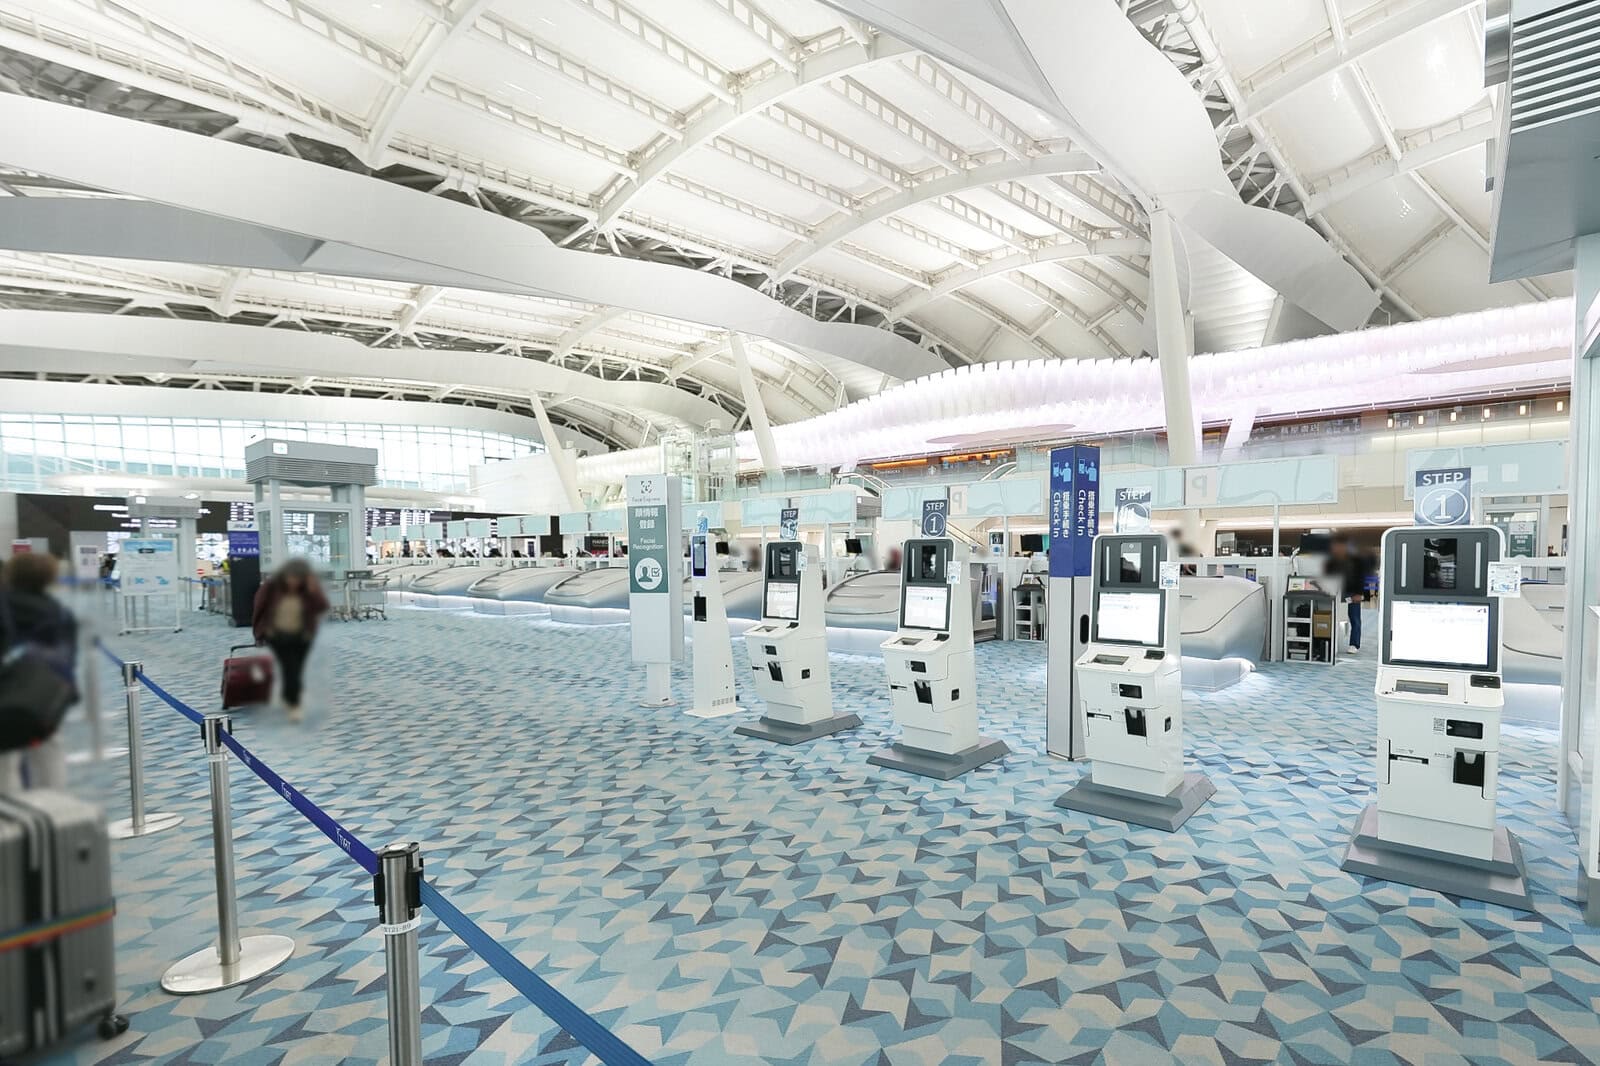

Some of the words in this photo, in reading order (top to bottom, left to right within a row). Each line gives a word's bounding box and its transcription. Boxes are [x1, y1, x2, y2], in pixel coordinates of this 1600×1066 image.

[1422, 472, 1464, 486] STEP
[1119, 489, 1146, 501] STEP
[925, 502, 945, 511] STEP
[1053, 492, 1061, 526] Check
[1077, 489, 1086, 523] Check
[1434, 494, 1451, 520] 1
[783, 510, 797, 518] STEP
[930, 516, 938, 533] 1
[1053, 527, 1061, 538] In
[1077, 526, 1085, 536] In
[632, 543, 664, 551] Recognition
